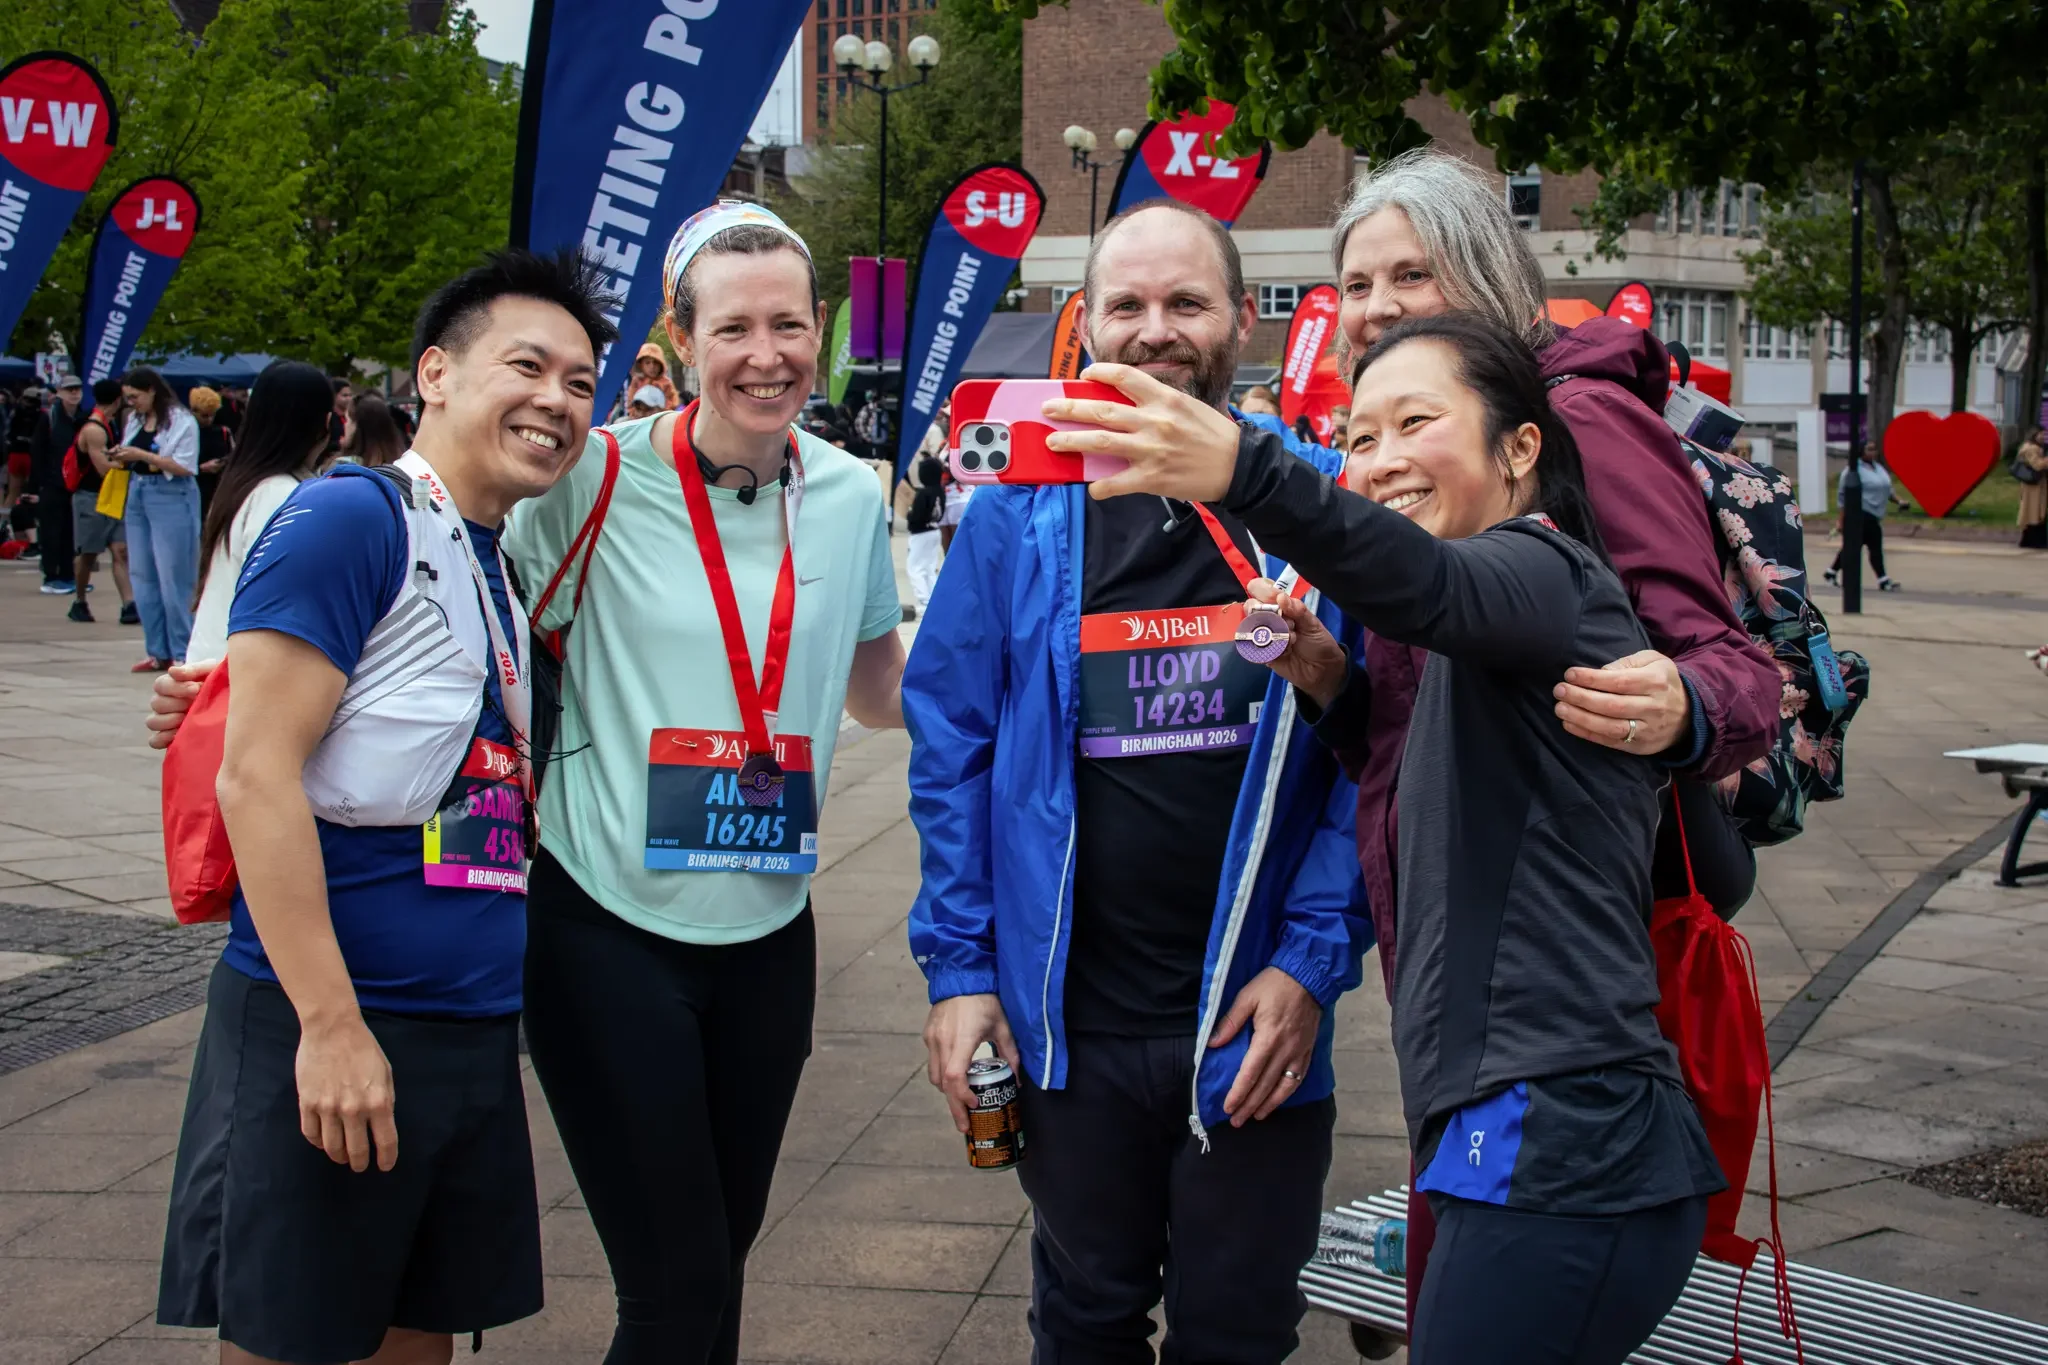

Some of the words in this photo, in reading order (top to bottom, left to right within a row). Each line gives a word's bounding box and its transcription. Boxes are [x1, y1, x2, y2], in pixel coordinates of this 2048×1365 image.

[0, 96, 97, 148] V-W
[0, 179, 30, 271] OINT
[136, 198, 183, 231] J-L
[964, 190, 1026, 228] S-U
[579, 81, 686, 378] ETING
[88, 310, 128, 386] MEETING
[113, 251, 147, 308] POINT
[911, 321, 958, 415] MEETING
[943, 252, 982, 318] POINT
[1285, 318, 1315, 378] VOLUNTEER
[1292, 316, 1328, 394] REGISTRATION
[1144, 616, 1211, 643] AJBell
[500, 651, 517, 686] 2026
[1128, 650, 1220, 688] LLOYD
[1133, 689, 1225, 728] 14234
[725, 739, 786, 764] AJll
[1121, 732, 1203, 753] BIRMINGHAM
[1207, 729, 1237, 746] 2026
[705, 773, 784, 809] AN
[650, 837, 663, 845] BLUE
[664, 838, 680, 846] WAVE
[705, 813, 787, 847] 16245
[803, 837, 816, 850] 10K
[467, 869, 523, 889] BIRMINGHAM
[688, 854, 761, 869] BIRMINGHAM
[763, 857, 790, 870] 2026
